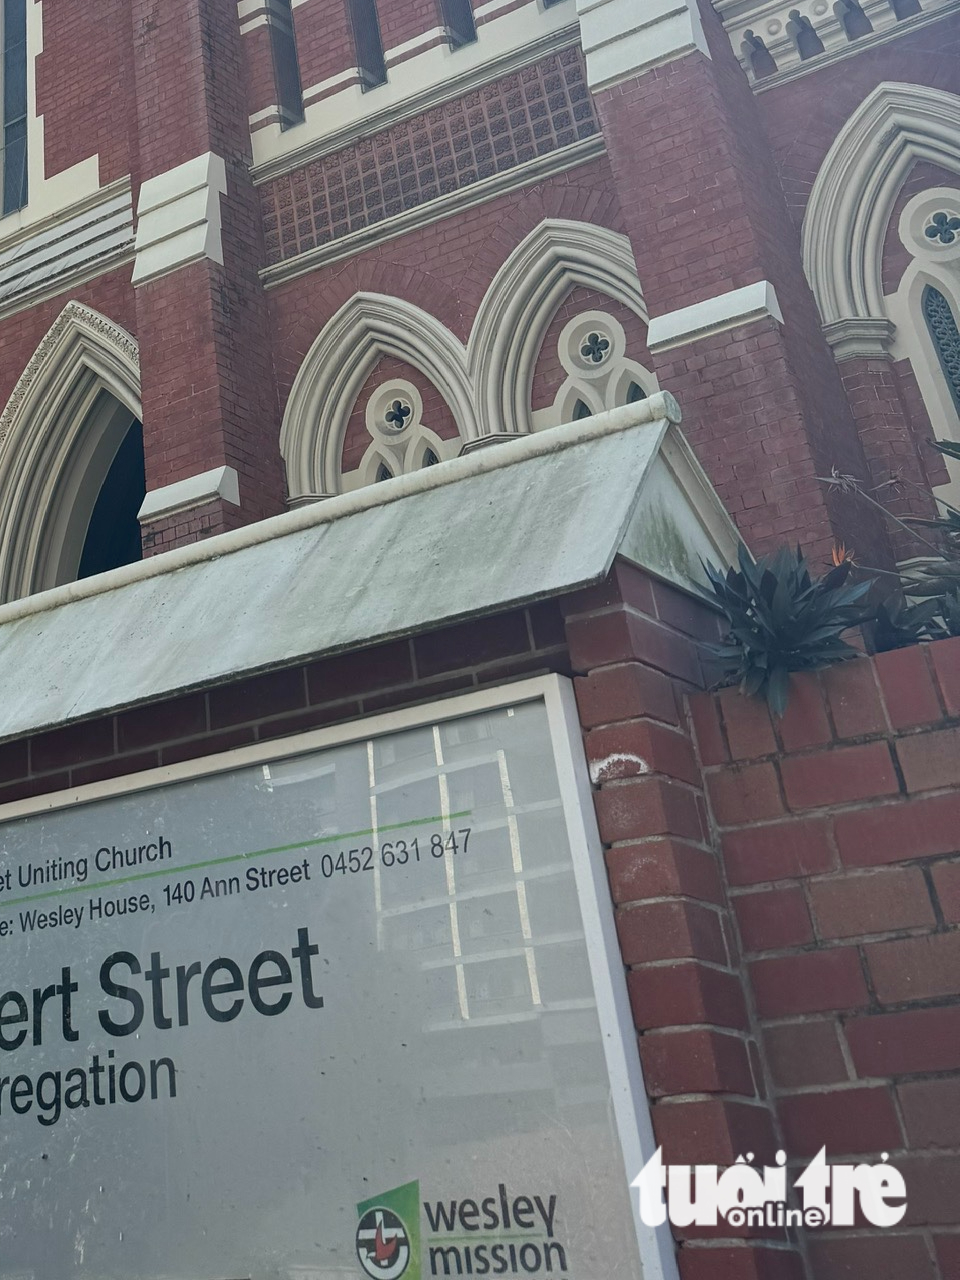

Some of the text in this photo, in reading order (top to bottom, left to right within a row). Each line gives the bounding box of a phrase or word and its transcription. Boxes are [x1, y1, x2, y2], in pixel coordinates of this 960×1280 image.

[18, 857, 88, 888] Uniting
[95, 836, 172, 871] Church
[19, 905, 84, 932] Wesley
[89, 893, 155, 920] House,
[163, 880, 195, 906] 140
[200, 876, 240, 900] Ann
[245, 858, 311, 892] Street
[321, 847, 375, 878] 0452
[381, 837, 421, 868] 631
[430, 828, 472, 859] 847
[97, 927, 324, 1038] Street
[423, 1183, 557, 1238] wesley
[429, 1241, 568, 1276] mission
